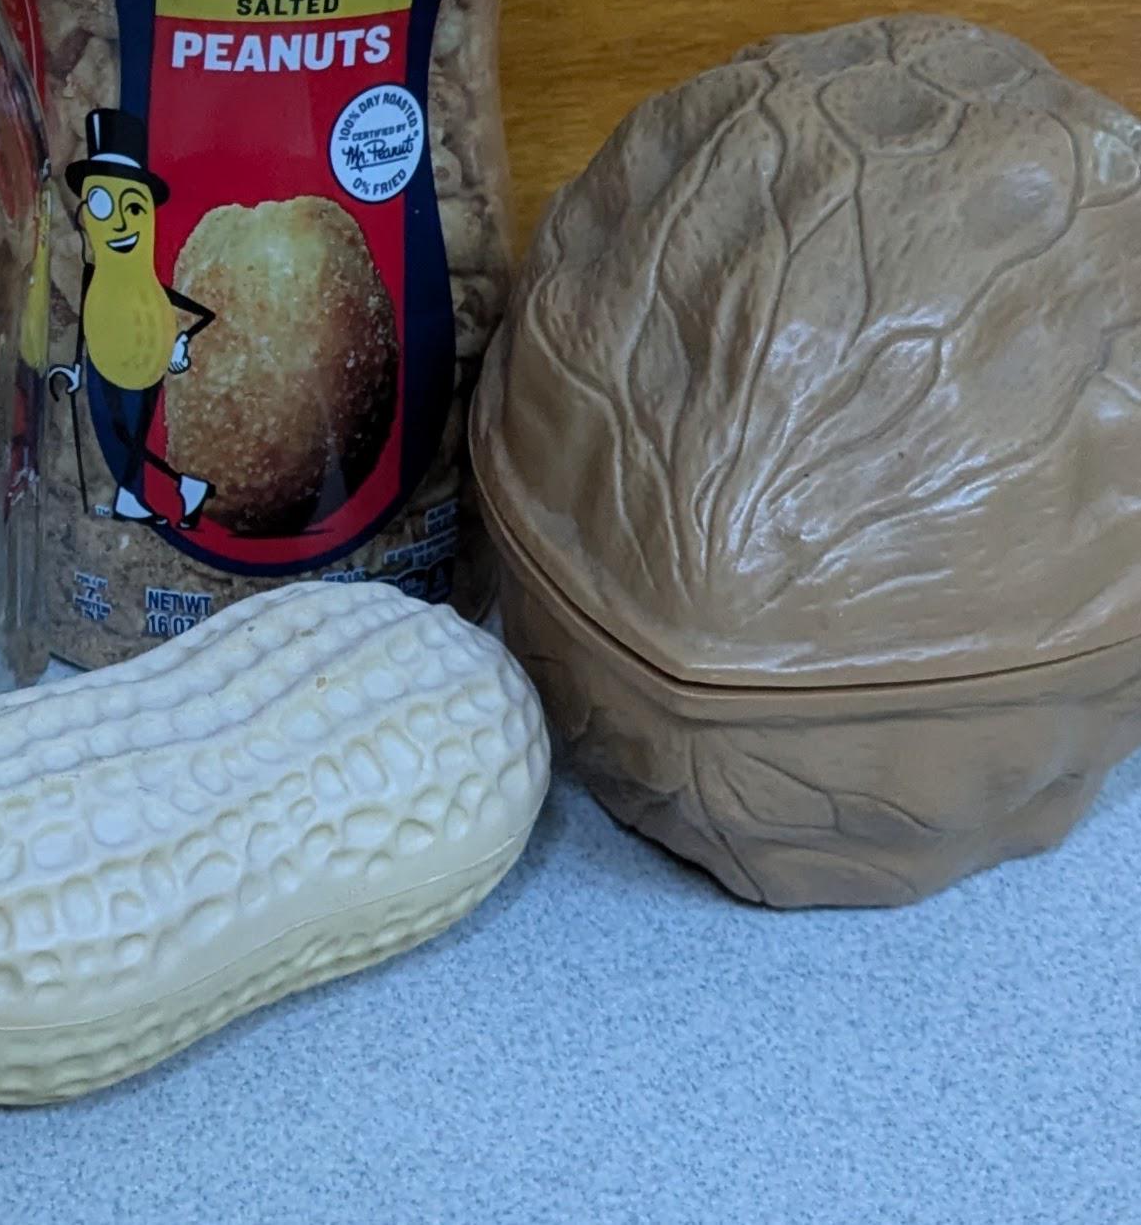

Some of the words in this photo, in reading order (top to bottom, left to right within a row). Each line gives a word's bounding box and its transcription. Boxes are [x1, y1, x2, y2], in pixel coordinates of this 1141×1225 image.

[171, 24, 392, 73] PEANUTS
[339, 110, 360, 141] 100%
[358, 94, 381, 114] DRY
[382, 92, 418, 128] ROASTED
[352, 126, 395, 142] CERTIFIED
[396, 123, 407, 134] BY
[363, 134, 415, 162] Peanut
[352, 177, 371, 195] 0%
[372, 168, 407, 196] FRIED
[147, 589, 180, 611] NET
[183, 593, 212, 615] WT
[147, 613, 169, 634] 16
